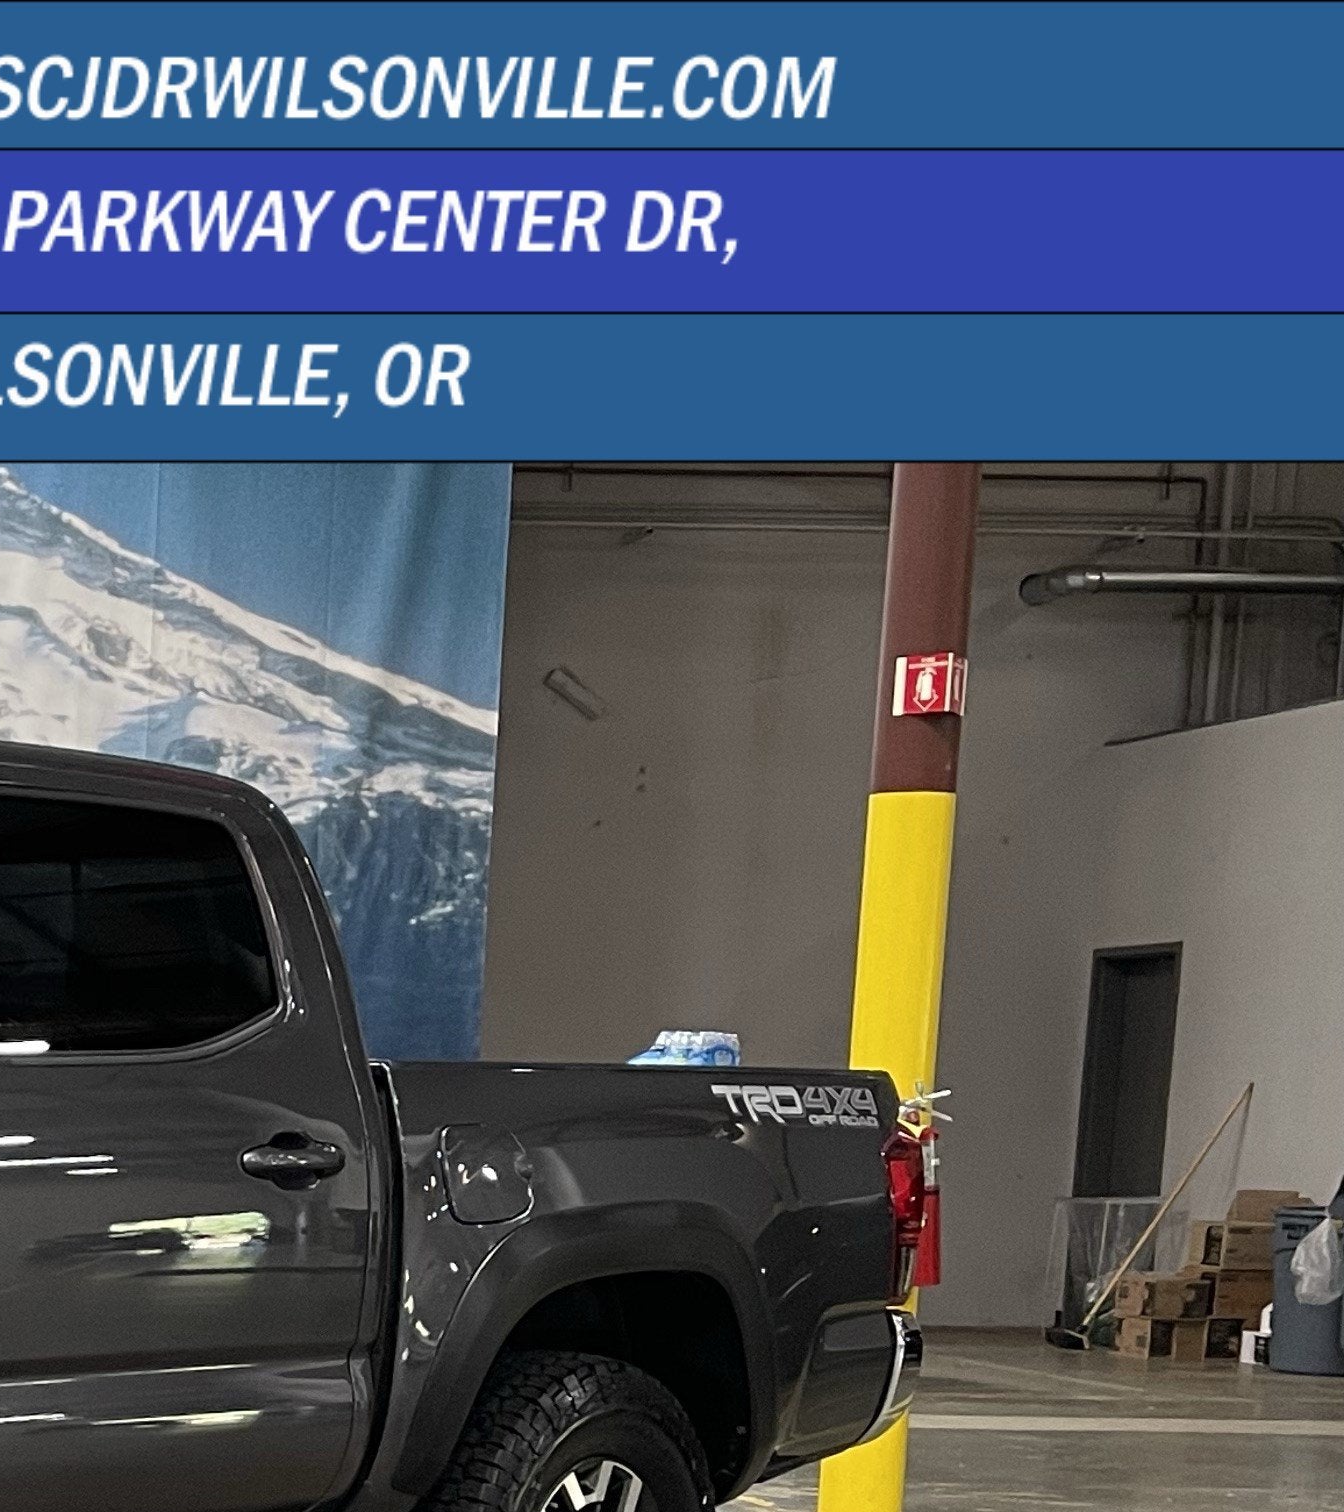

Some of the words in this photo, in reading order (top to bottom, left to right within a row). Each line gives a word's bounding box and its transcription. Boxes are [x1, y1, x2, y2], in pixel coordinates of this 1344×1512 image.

[711, 1084, 805, 1125] TRD
[808, 1114, 838, 1126] OFF
[840, 1115, 879, 1128] ROAD
